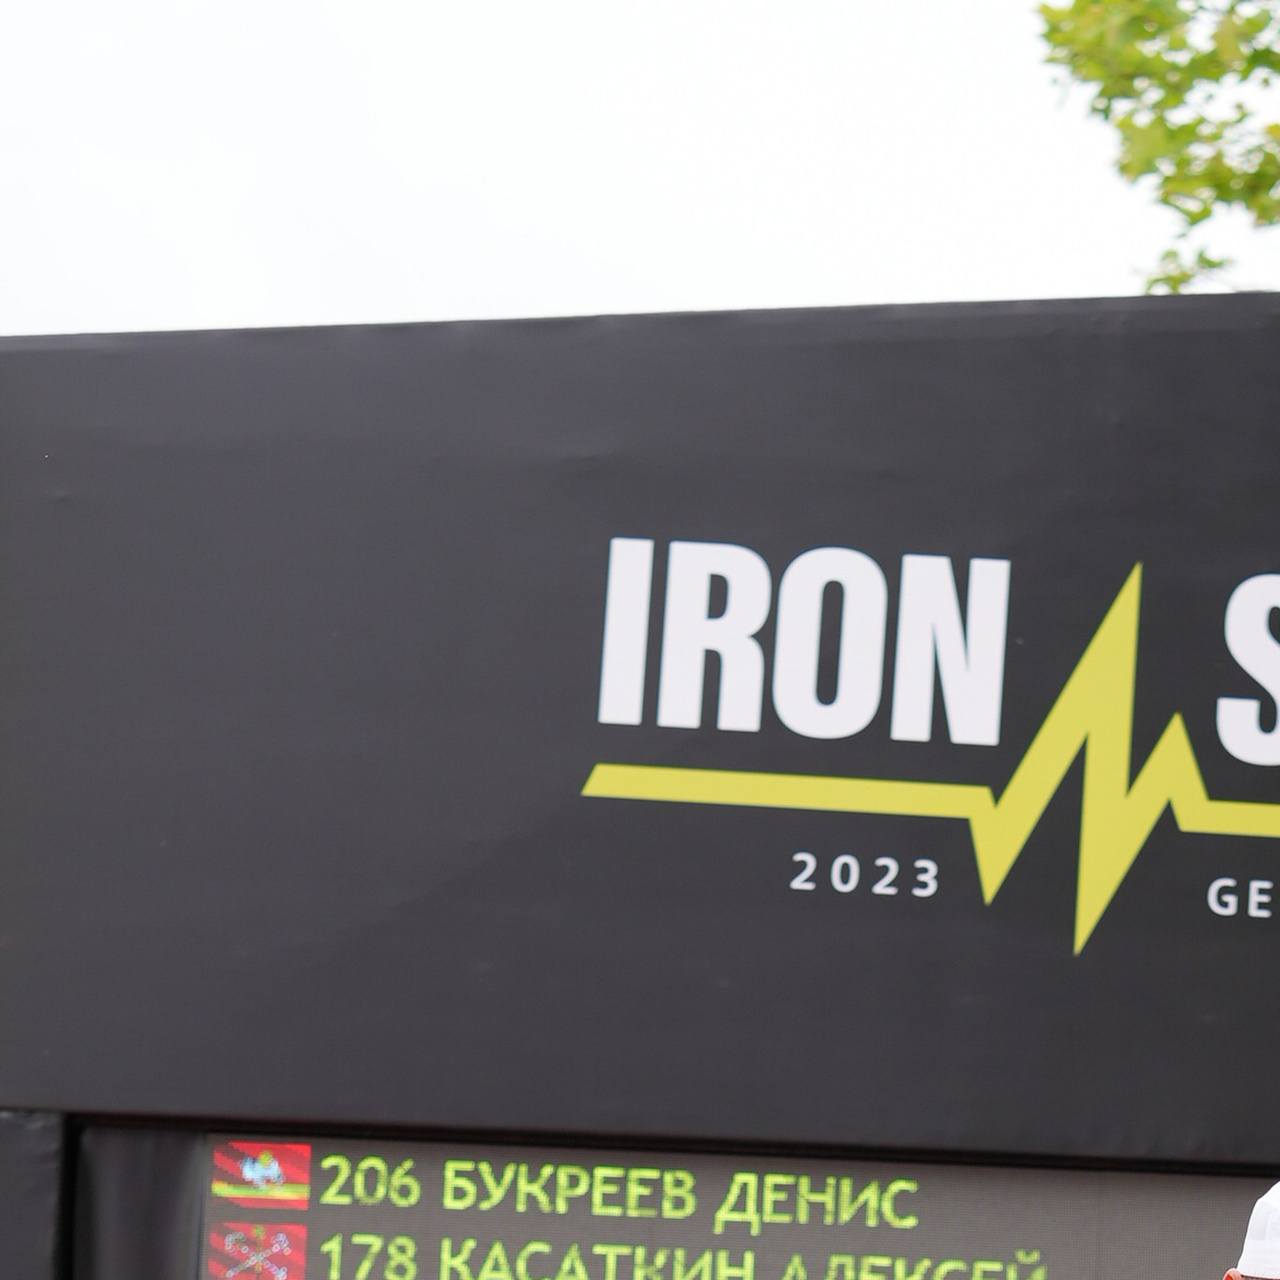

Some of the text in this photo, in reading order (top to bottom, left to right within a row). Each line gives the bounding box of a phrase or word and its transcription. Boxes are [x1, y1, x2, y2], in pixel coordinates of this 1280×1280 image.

[598, 537, 1011, 746] IRON
[790, 852, 939, 897] 2023
[319, 1153, 422, 1208] 206
[441, 1158, 698, 1220] БУКРЕЕВ
[712, 1170, 920, 1237] ДЕНИС
